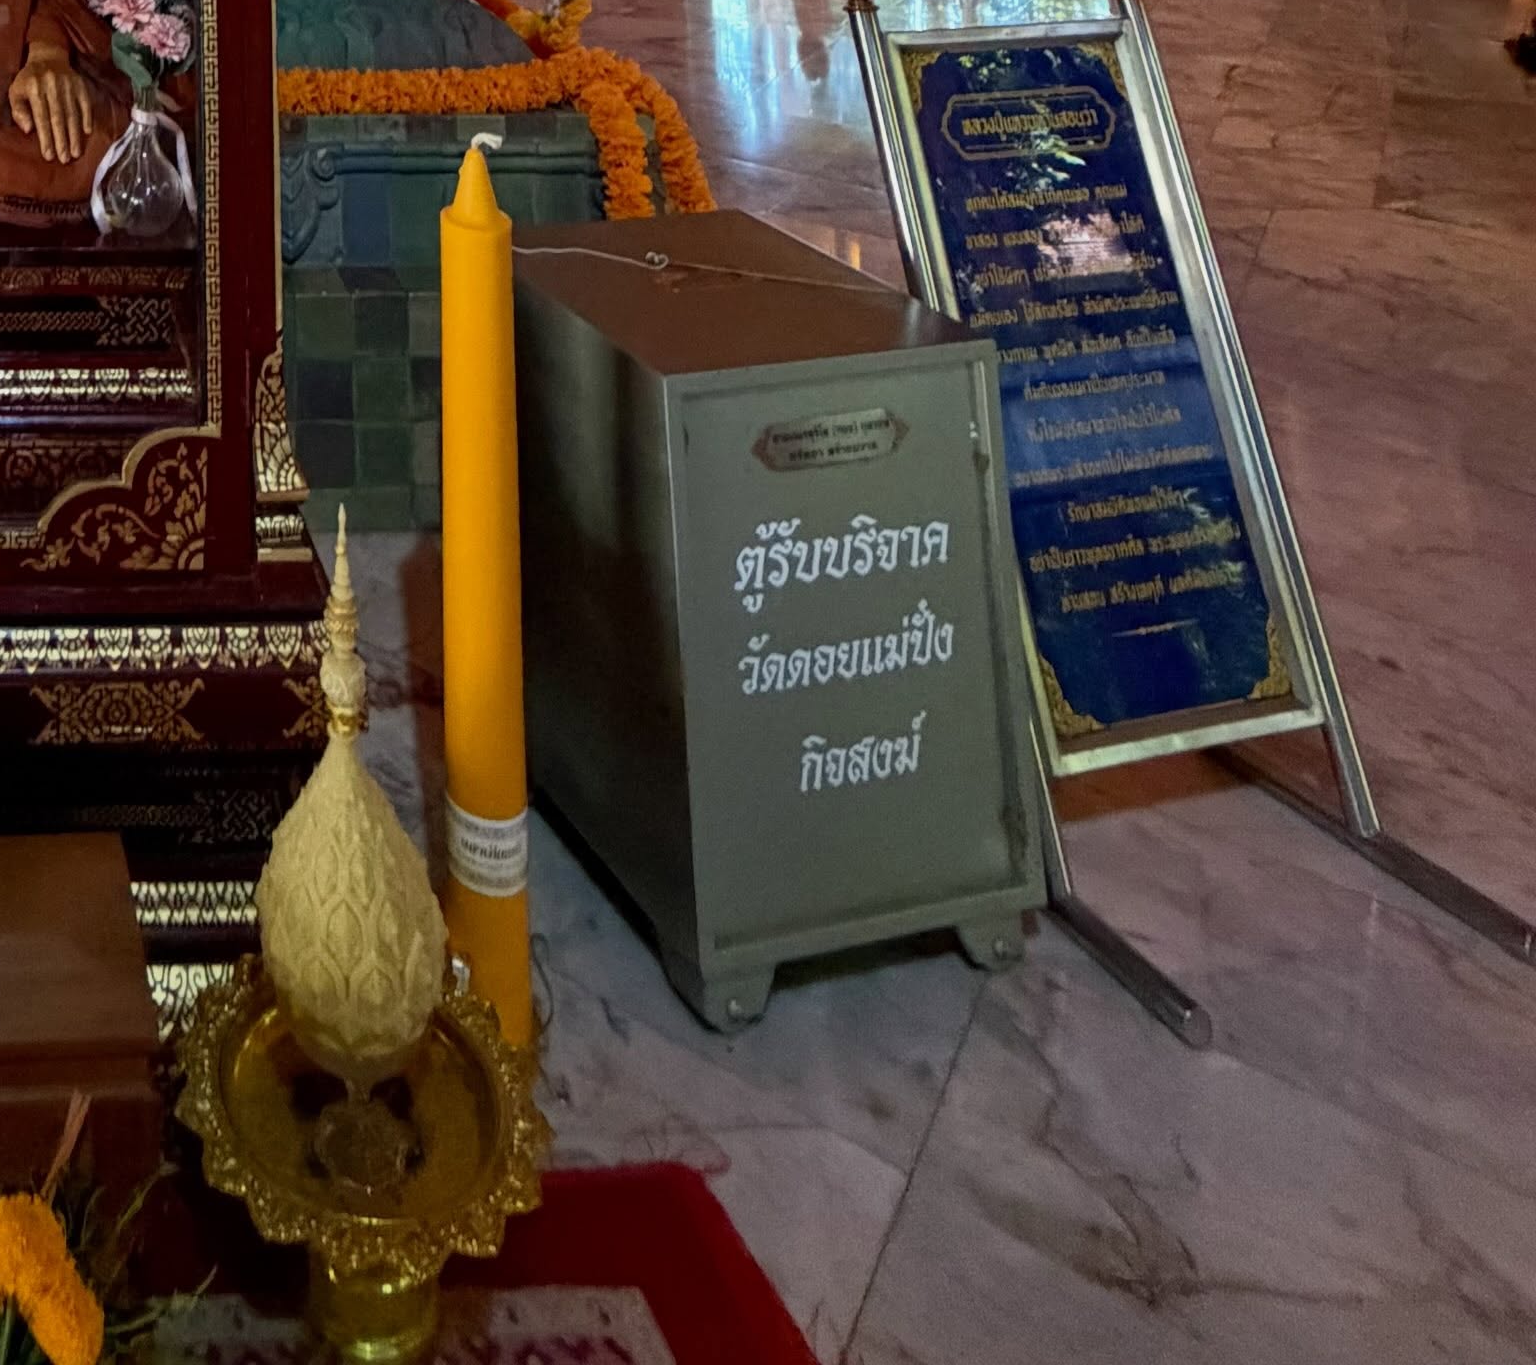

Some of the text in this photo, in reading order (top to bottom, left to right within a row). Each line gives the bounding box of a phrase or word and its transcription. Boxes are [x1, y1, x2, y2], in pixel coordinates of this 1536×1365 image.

[734, 515, 950, 613] ตู้รับบริจาค
[738, 598, 954, 695] วัดดอยแม่ปั๋ง
[800, 710, 927, 793] กิจสงฆ์
